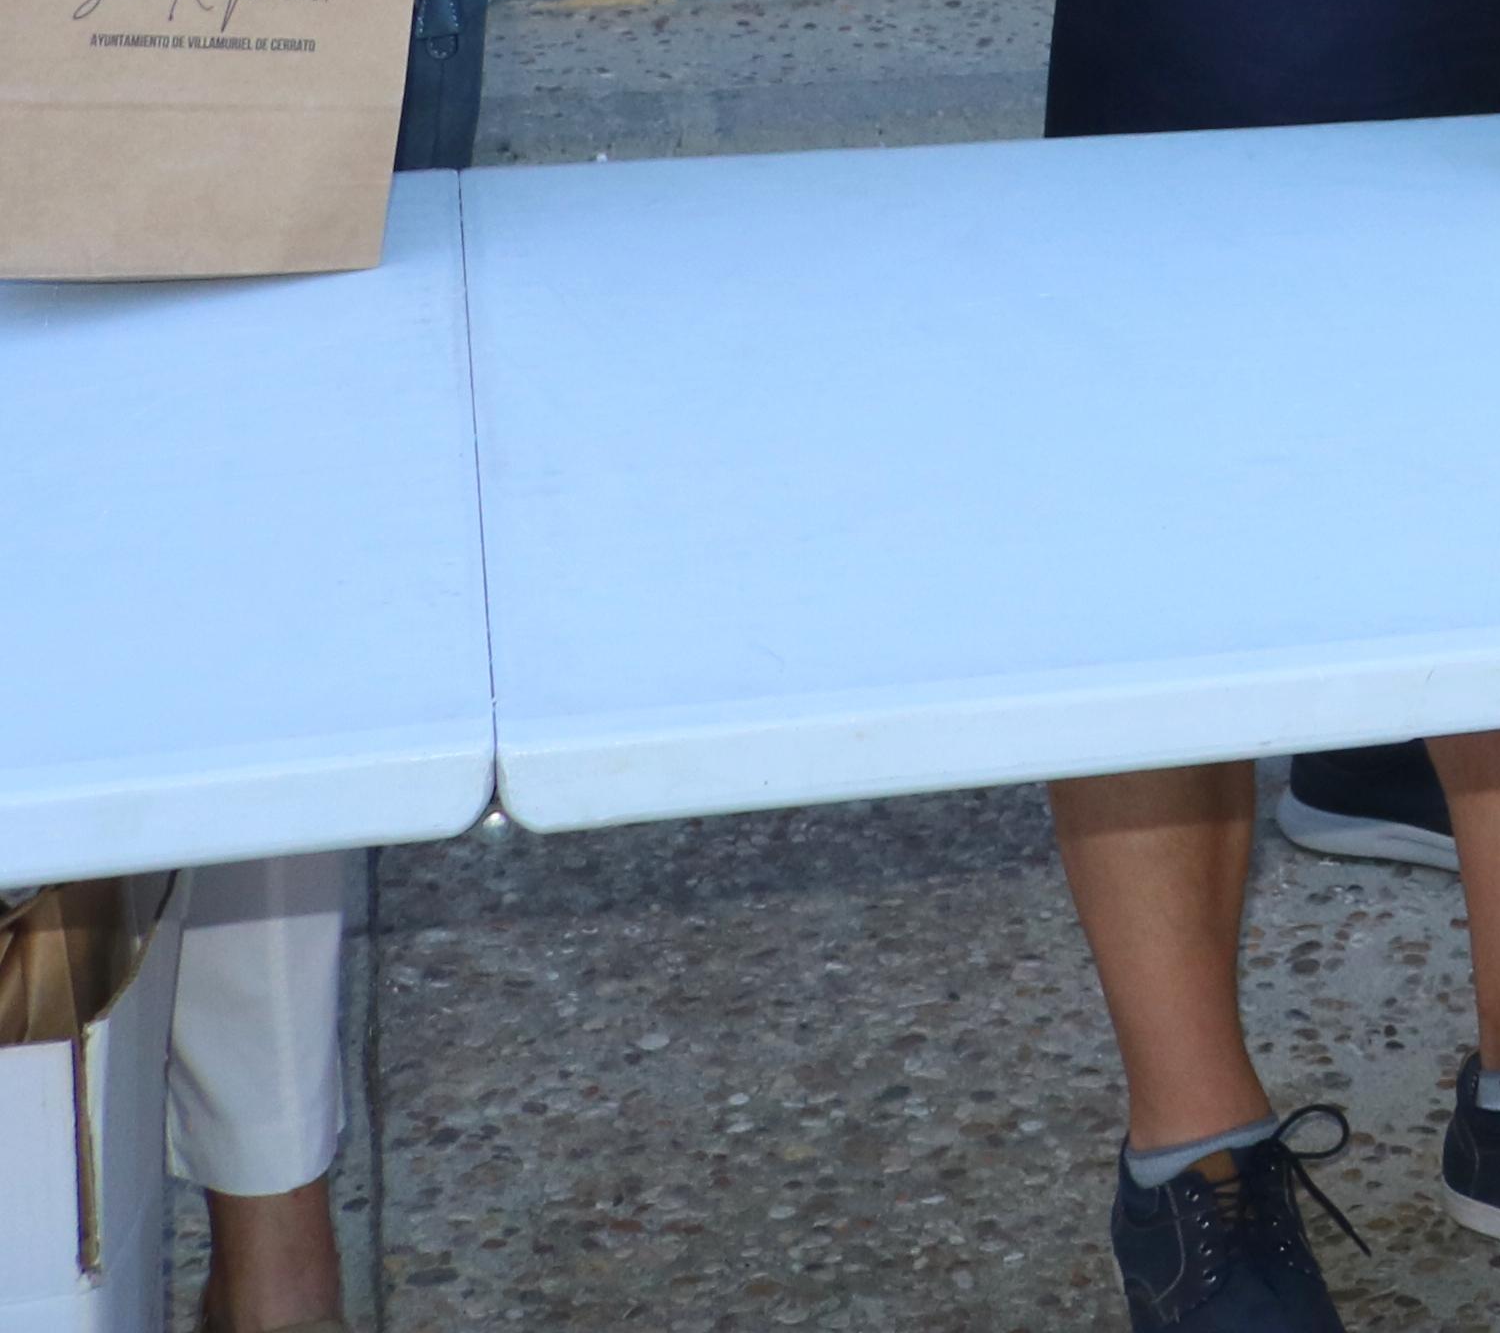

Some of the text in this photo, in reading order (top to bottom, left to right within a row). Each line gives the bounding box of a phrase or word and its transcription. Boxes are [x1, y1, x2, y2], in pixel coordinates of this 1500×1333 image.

[90, 33, 317, 53] AYUNTAMIENTO DE VILLAMURIEL DE CERRATO
